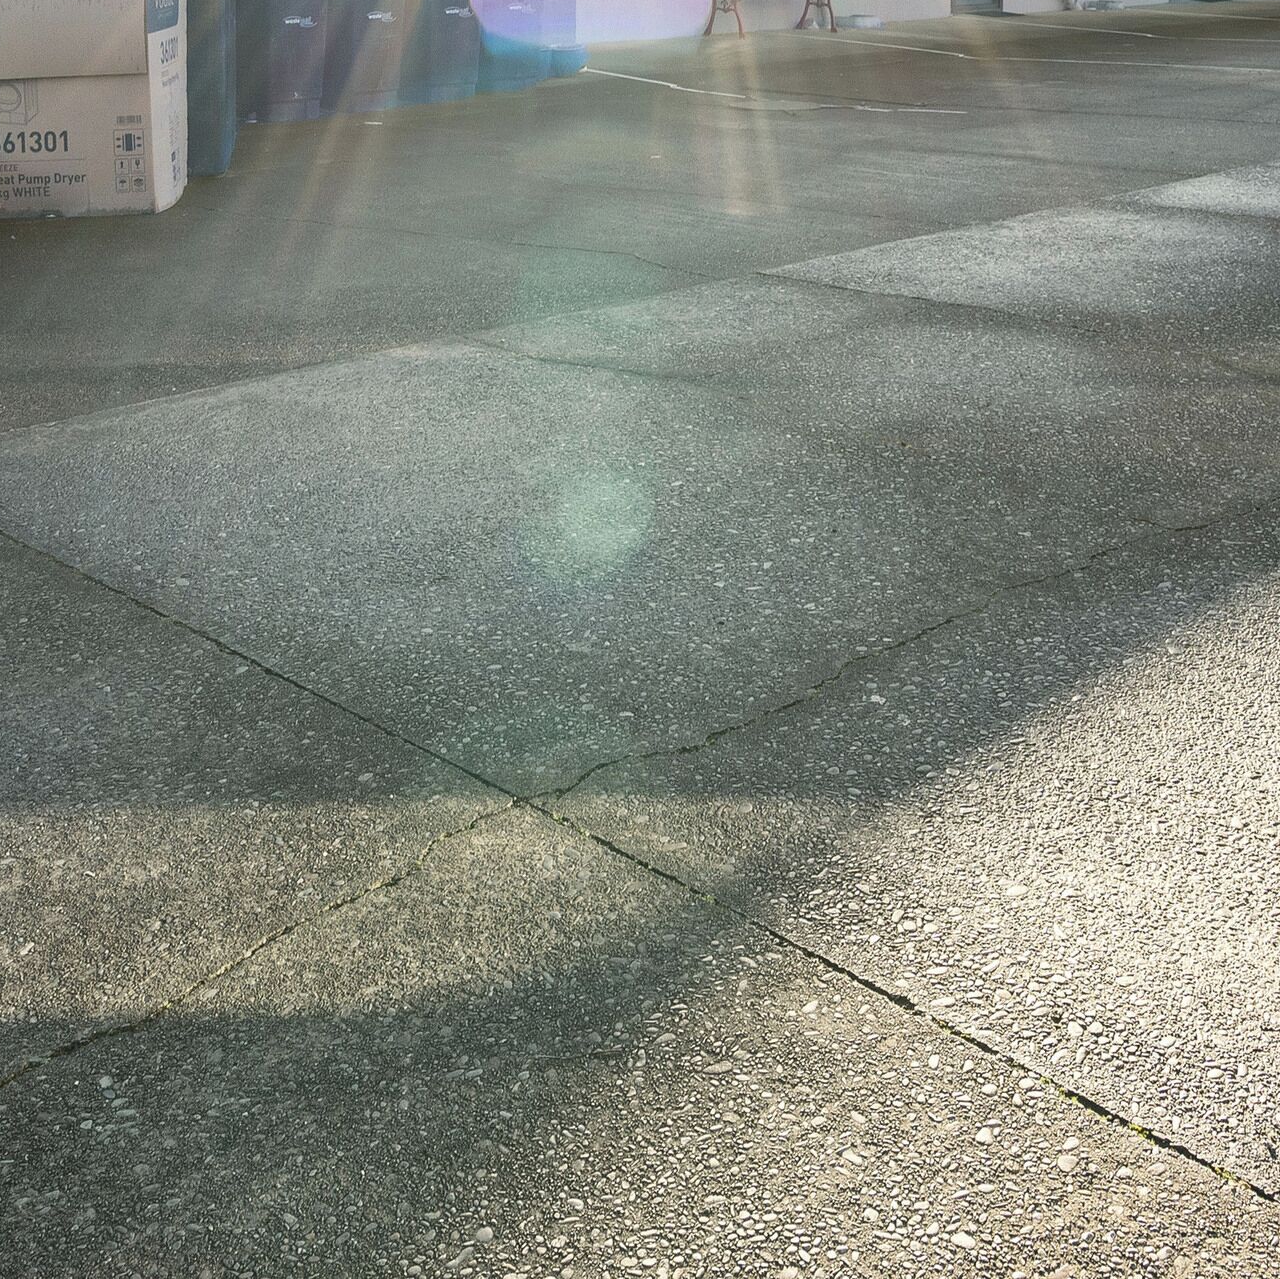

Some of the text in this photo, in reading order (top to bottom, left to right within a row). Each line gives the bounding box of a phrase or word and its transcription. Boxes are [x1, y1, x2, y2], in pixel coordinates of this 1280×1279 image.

[18, 173, 51, 186] Pump
[54, 172, 87, 186] Dryer
[12, 186, 51, 198] WHITE
